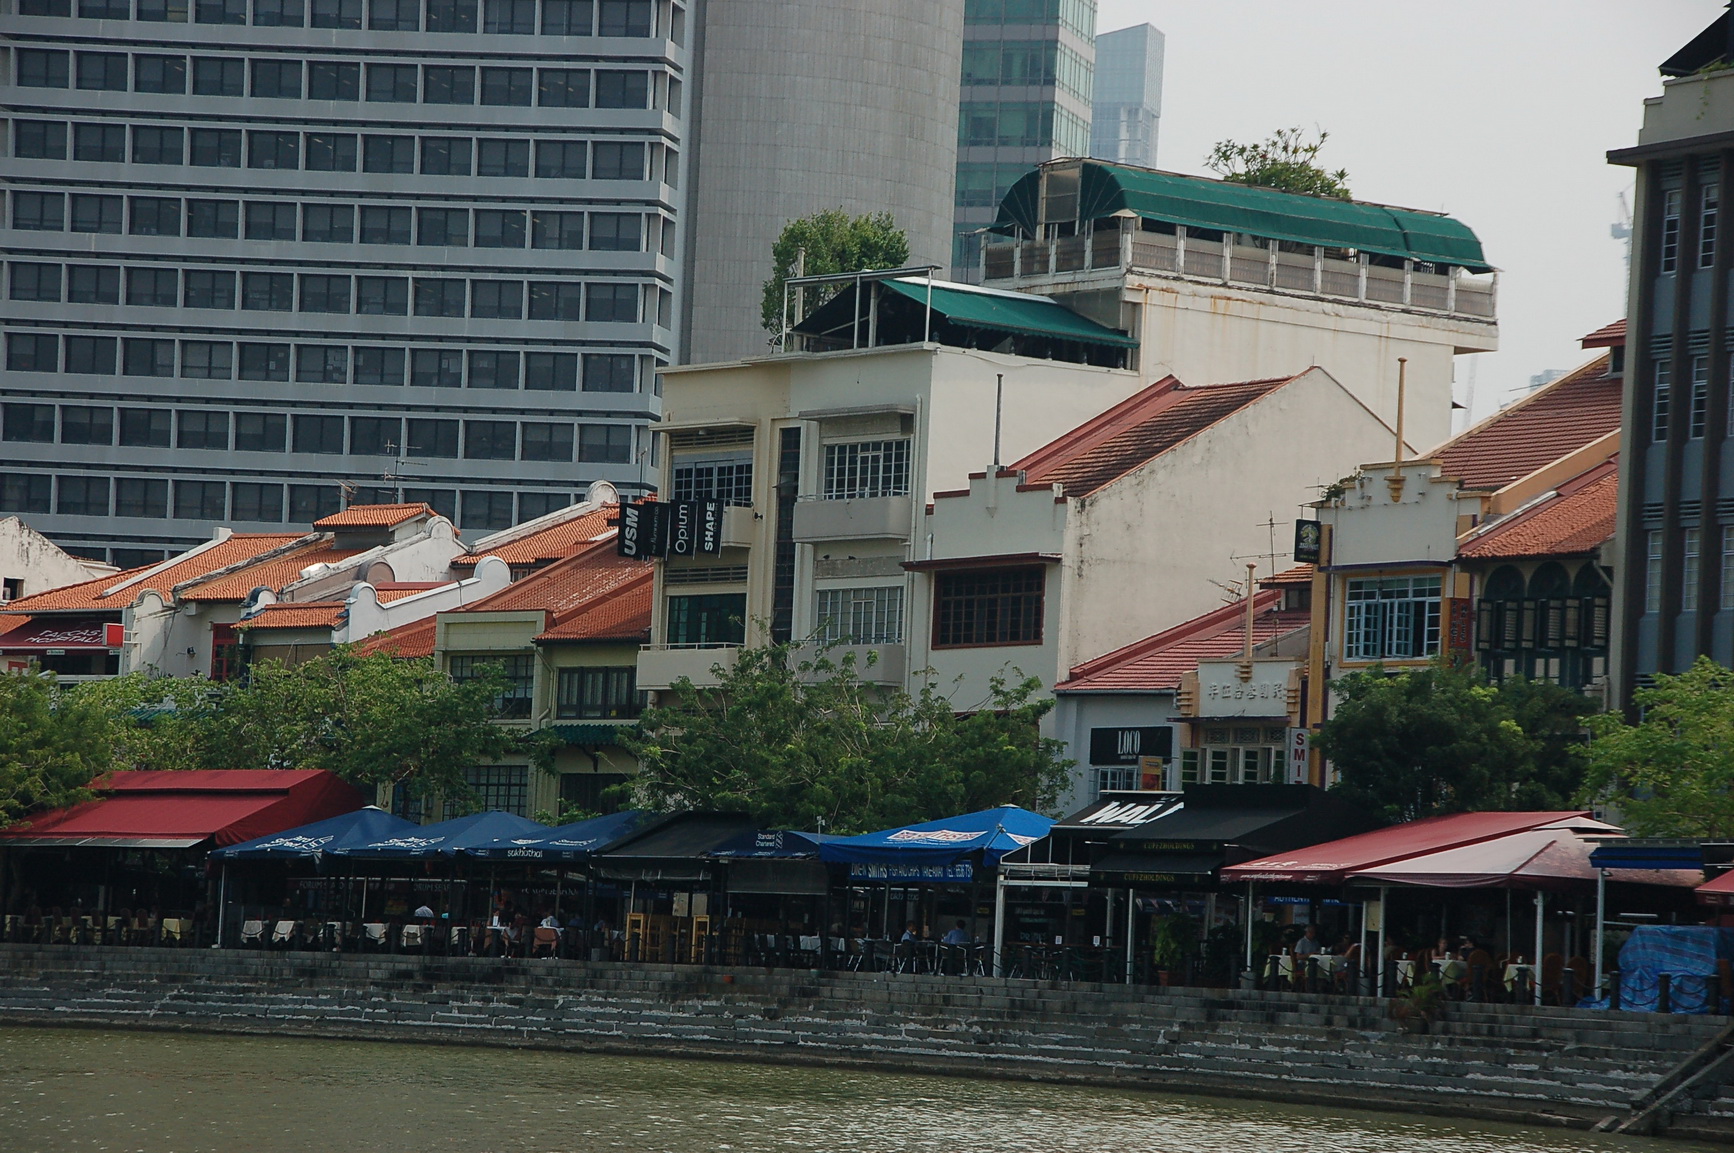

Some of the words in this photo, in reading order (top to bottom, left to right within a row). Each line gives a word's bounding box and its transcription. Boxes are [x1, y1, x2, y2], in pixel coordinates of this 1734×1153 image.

[624, 506, 639, 556] USM
[674, 503, 689, 553] Opium
[704, 501, 715, 552] SHAPE
[1117, 730, 1141, 755] LOCO
[1293, 732, 1306, 784] SMI
[757, 832, 776, 841] Standard
